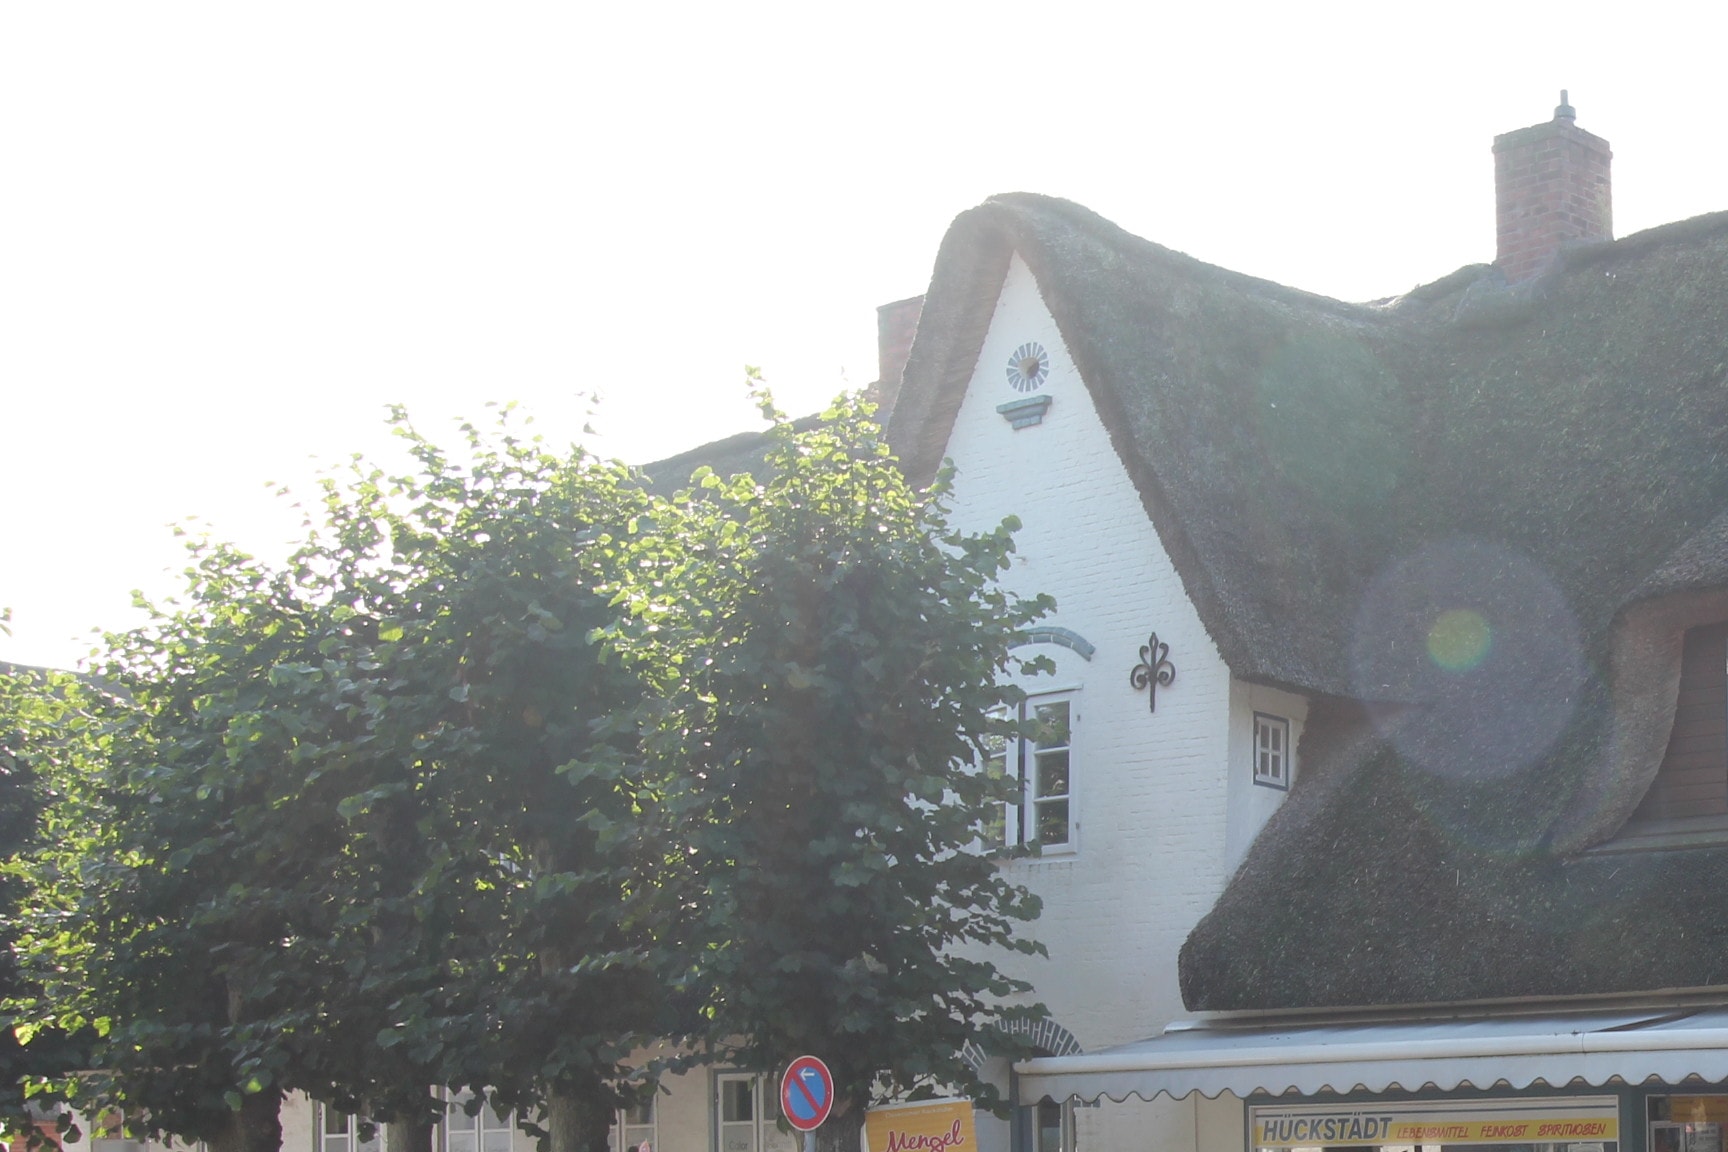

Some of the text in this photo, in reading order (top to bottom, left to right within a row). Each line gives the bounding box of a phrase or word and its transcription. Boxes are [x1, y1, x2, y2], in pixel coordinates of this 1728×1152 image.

[1262, 1113, 1606, 1142] HÜCKSTÄDT LEBENSMITTEL FEINKOST SPIRITUOSEN
